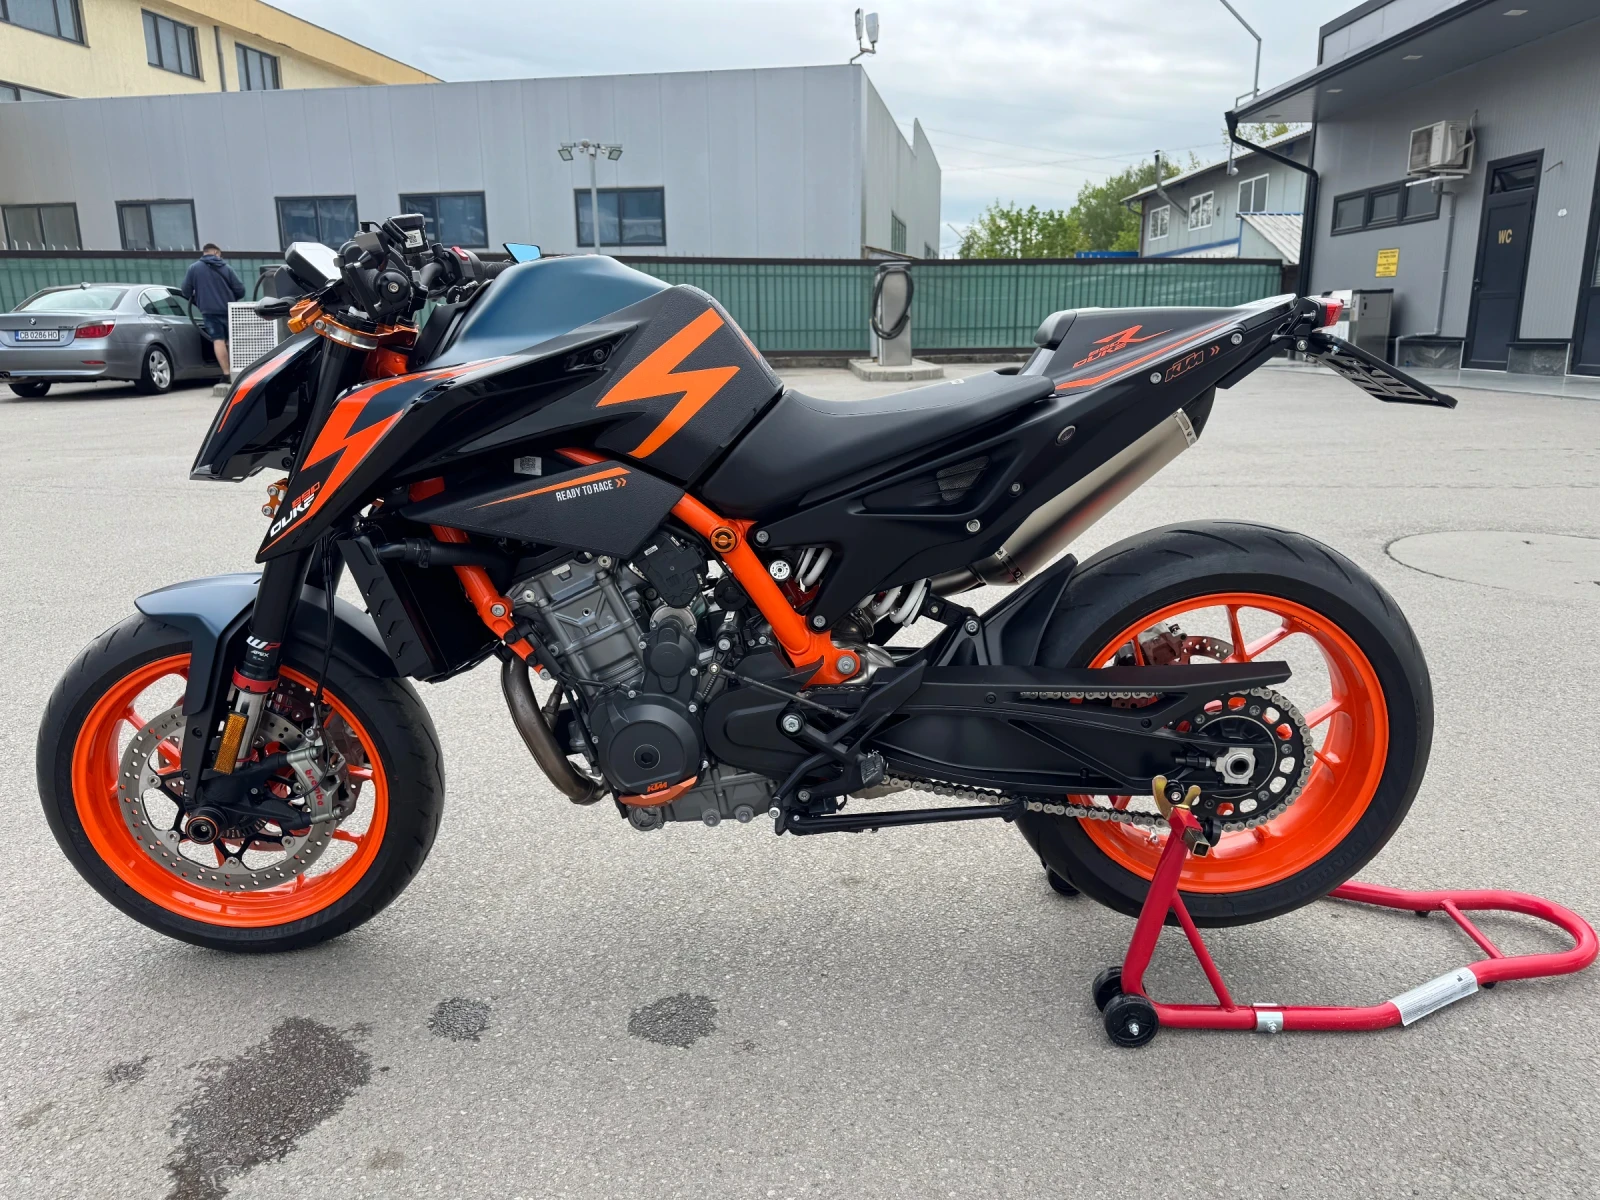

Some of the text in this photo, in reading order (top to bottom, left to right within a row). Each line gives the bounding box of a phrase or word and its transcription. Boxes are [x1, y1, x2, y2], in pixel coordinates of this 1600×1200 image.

[1498, 229, 1513, 244] WC
[30, 331, 47, 339] 0286
[1164, 350, 1204, 383] KTM
[555, 480, 614, 502] READY TO RACE
[269, 494, 315, 538] DUKE
[246, 635, 281, 651] WP
[305, 769, 324, 806] brembo
[646, 781, 668, 793] KTM
